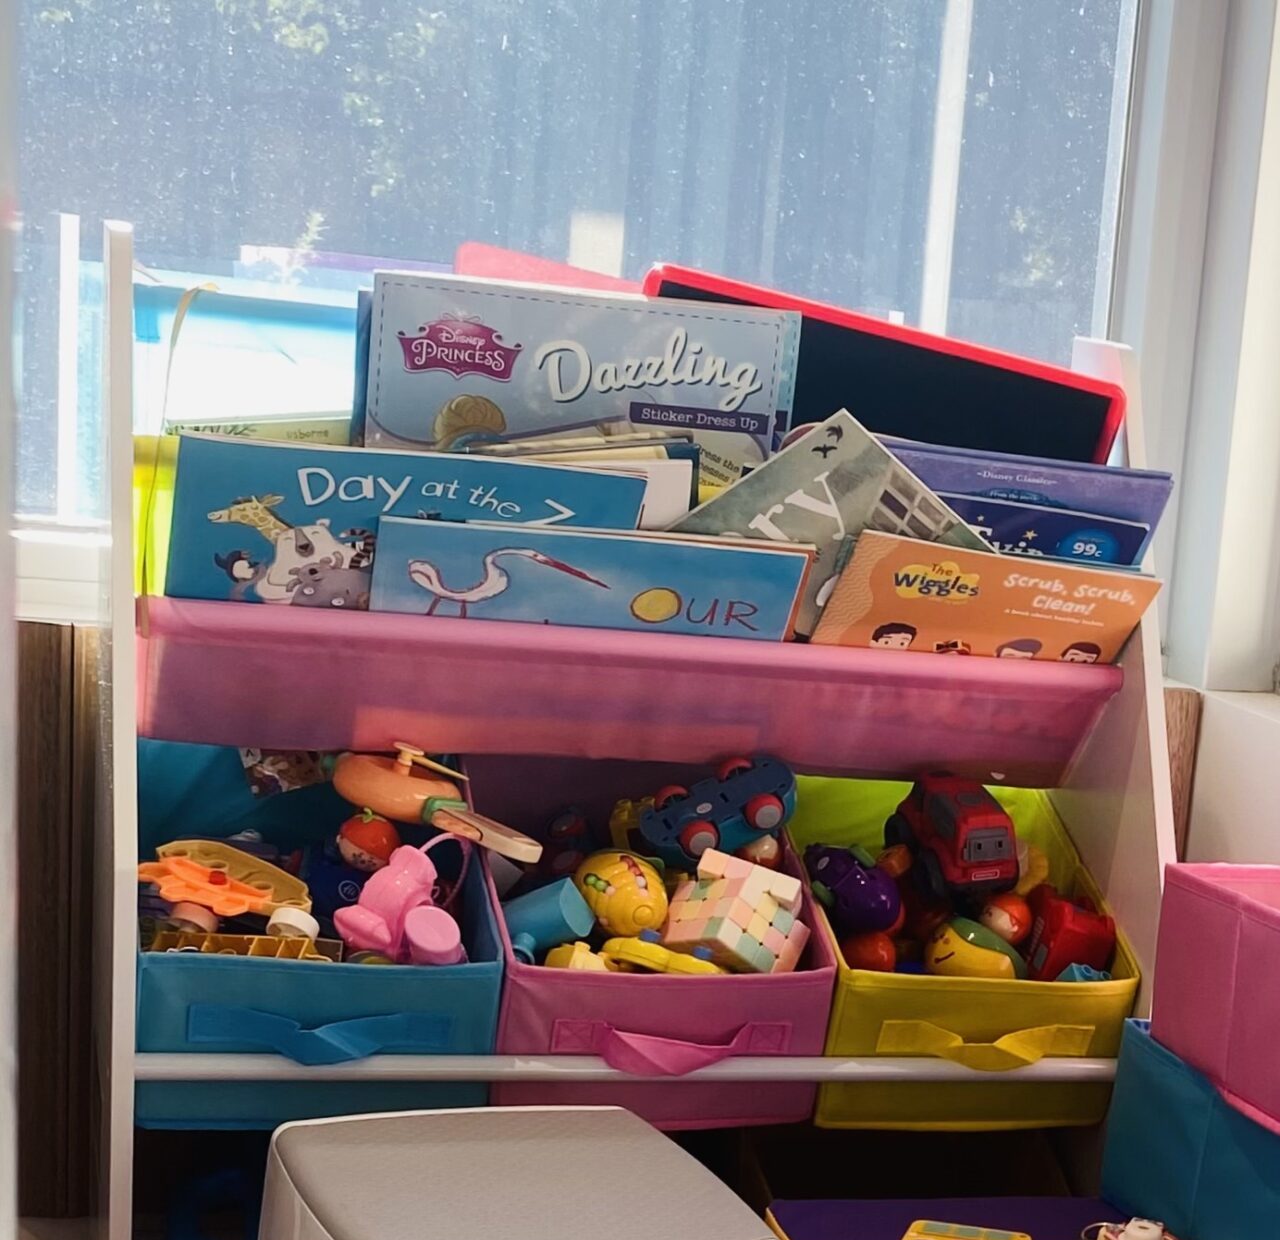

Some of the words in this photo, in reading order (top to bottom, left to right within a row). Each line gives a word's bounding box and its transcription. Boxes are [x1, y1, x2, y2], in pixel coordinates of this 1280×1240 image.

[411, 339, 505, 371] PRINCESS
[534, 326, 763, 413] Dazzling
[641, 408, 694, 424] Sticker
[695, 413, 737, 429] Dress
[739, 416, 759, 431] Up
[297, 467, 412, 512] Day
[421, 479, 460, 499] at
[468, 486, 522, 518] the
[931, 563, 953, 576] The
[893, 572, 979, 597] Wiggles
[1032, 594, 1096, 616] Clean!
